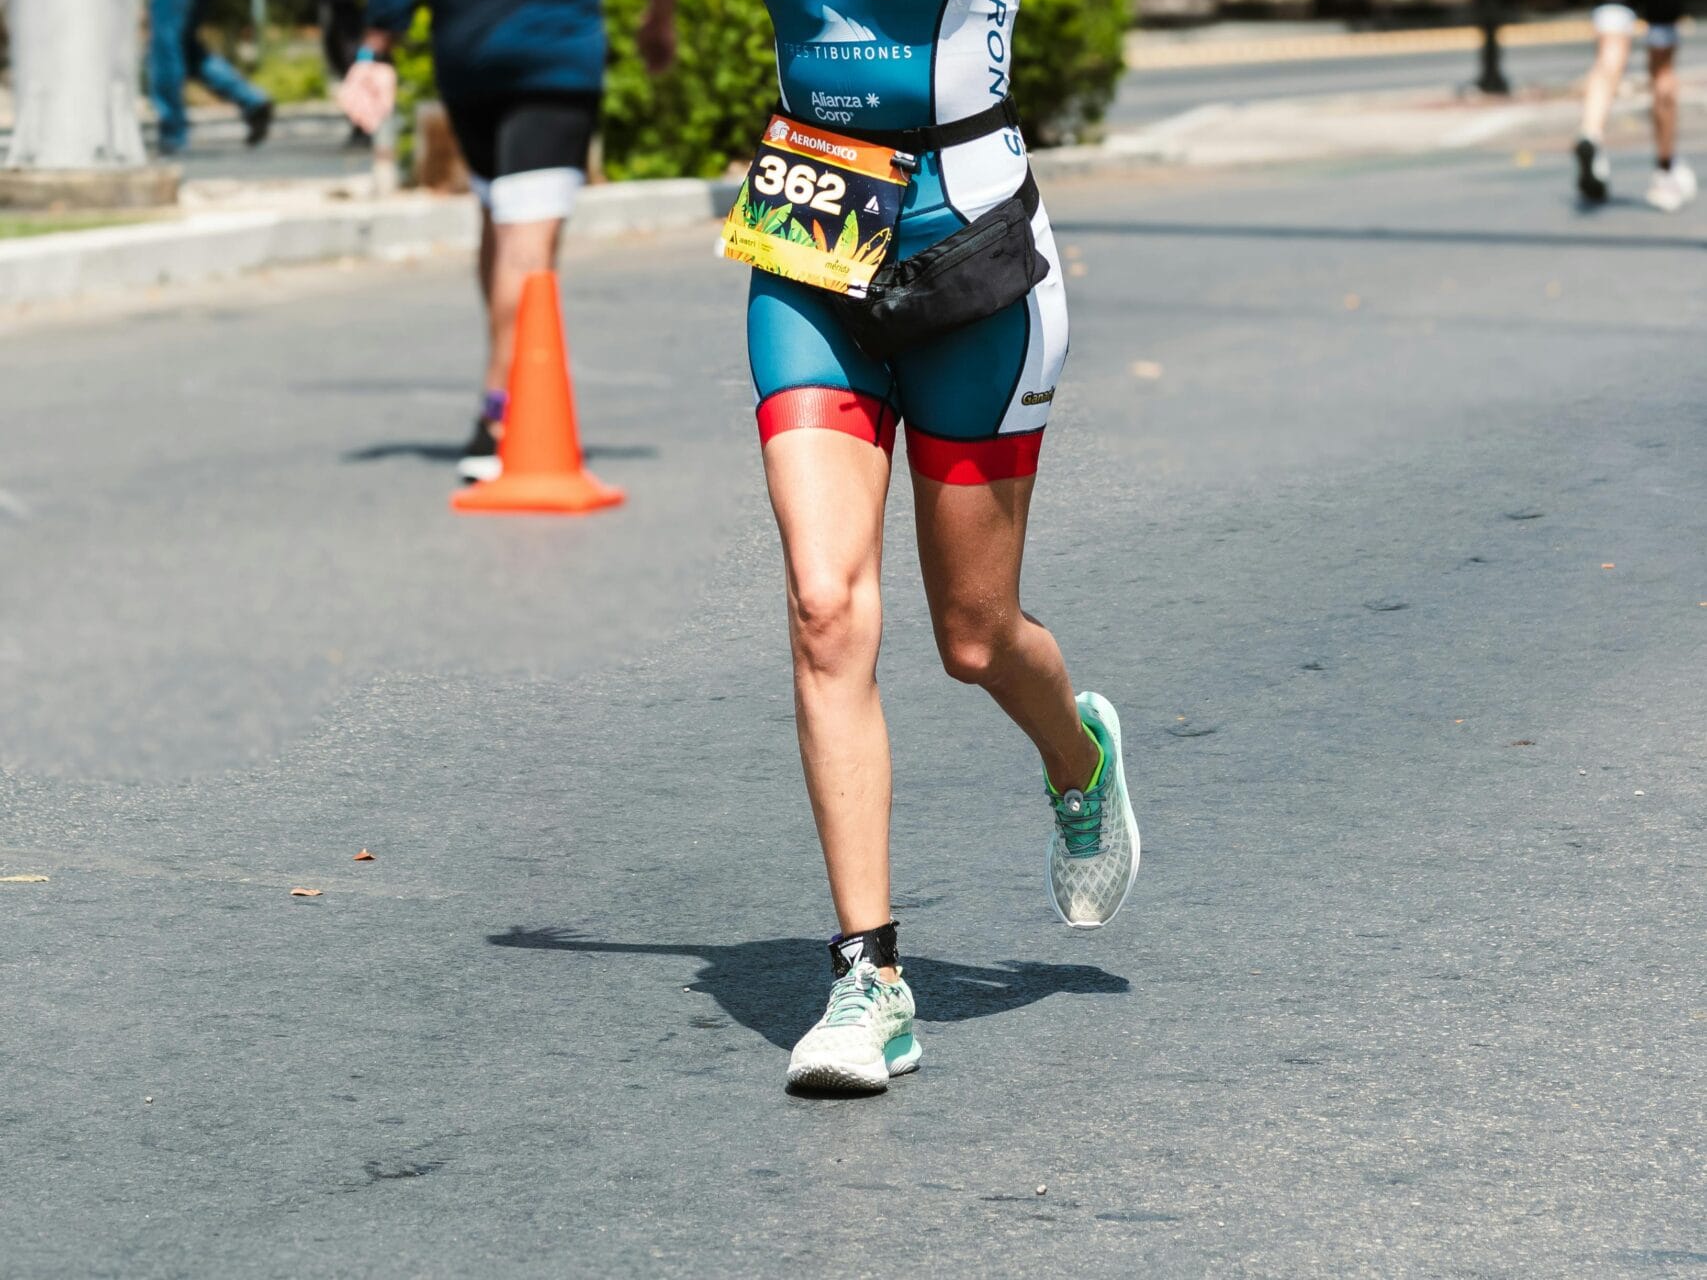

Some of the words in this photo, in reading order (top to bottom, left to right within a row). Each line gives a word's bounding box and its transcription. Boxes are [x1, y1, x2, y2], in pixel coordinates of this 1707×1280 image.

[814, 45, 913, 60] TIBURONES
[811, 90, 863, 108] Alianza
[754, 154, 846, 216] 362
